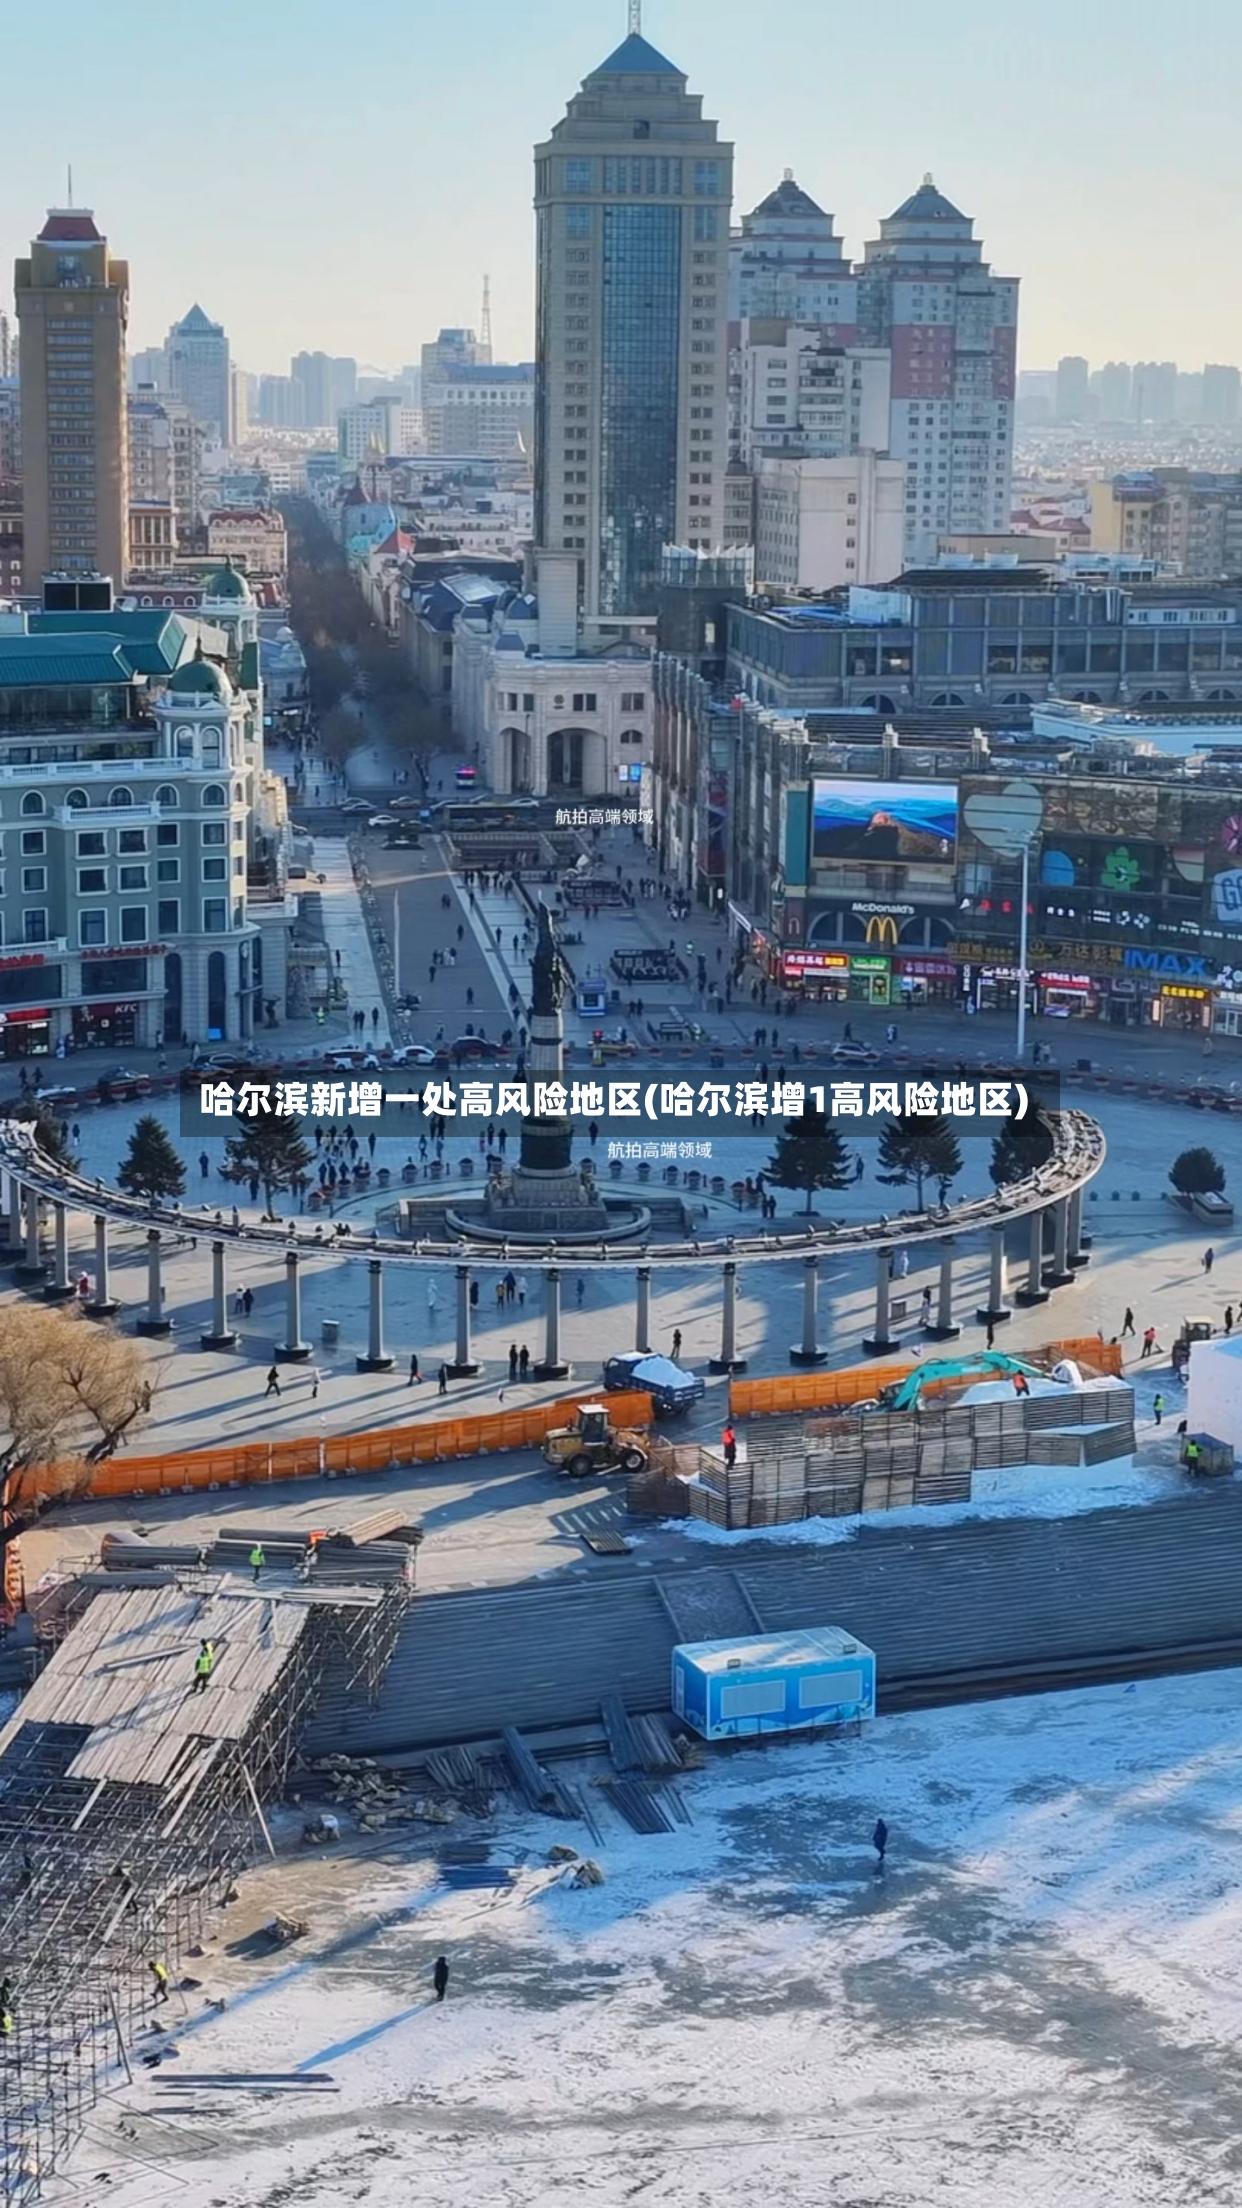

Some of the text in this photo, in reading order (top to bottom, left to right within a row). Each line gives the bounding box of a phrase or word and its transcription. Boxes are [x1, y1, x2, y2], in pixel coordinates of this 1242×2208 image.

[852, 902, 915, 915] McDonald's
[1060, 943, 1122, 962] 万达影城
[1124, 948, 1209, 976] IMAX
[115, 1003, 137, 1013] KFC
